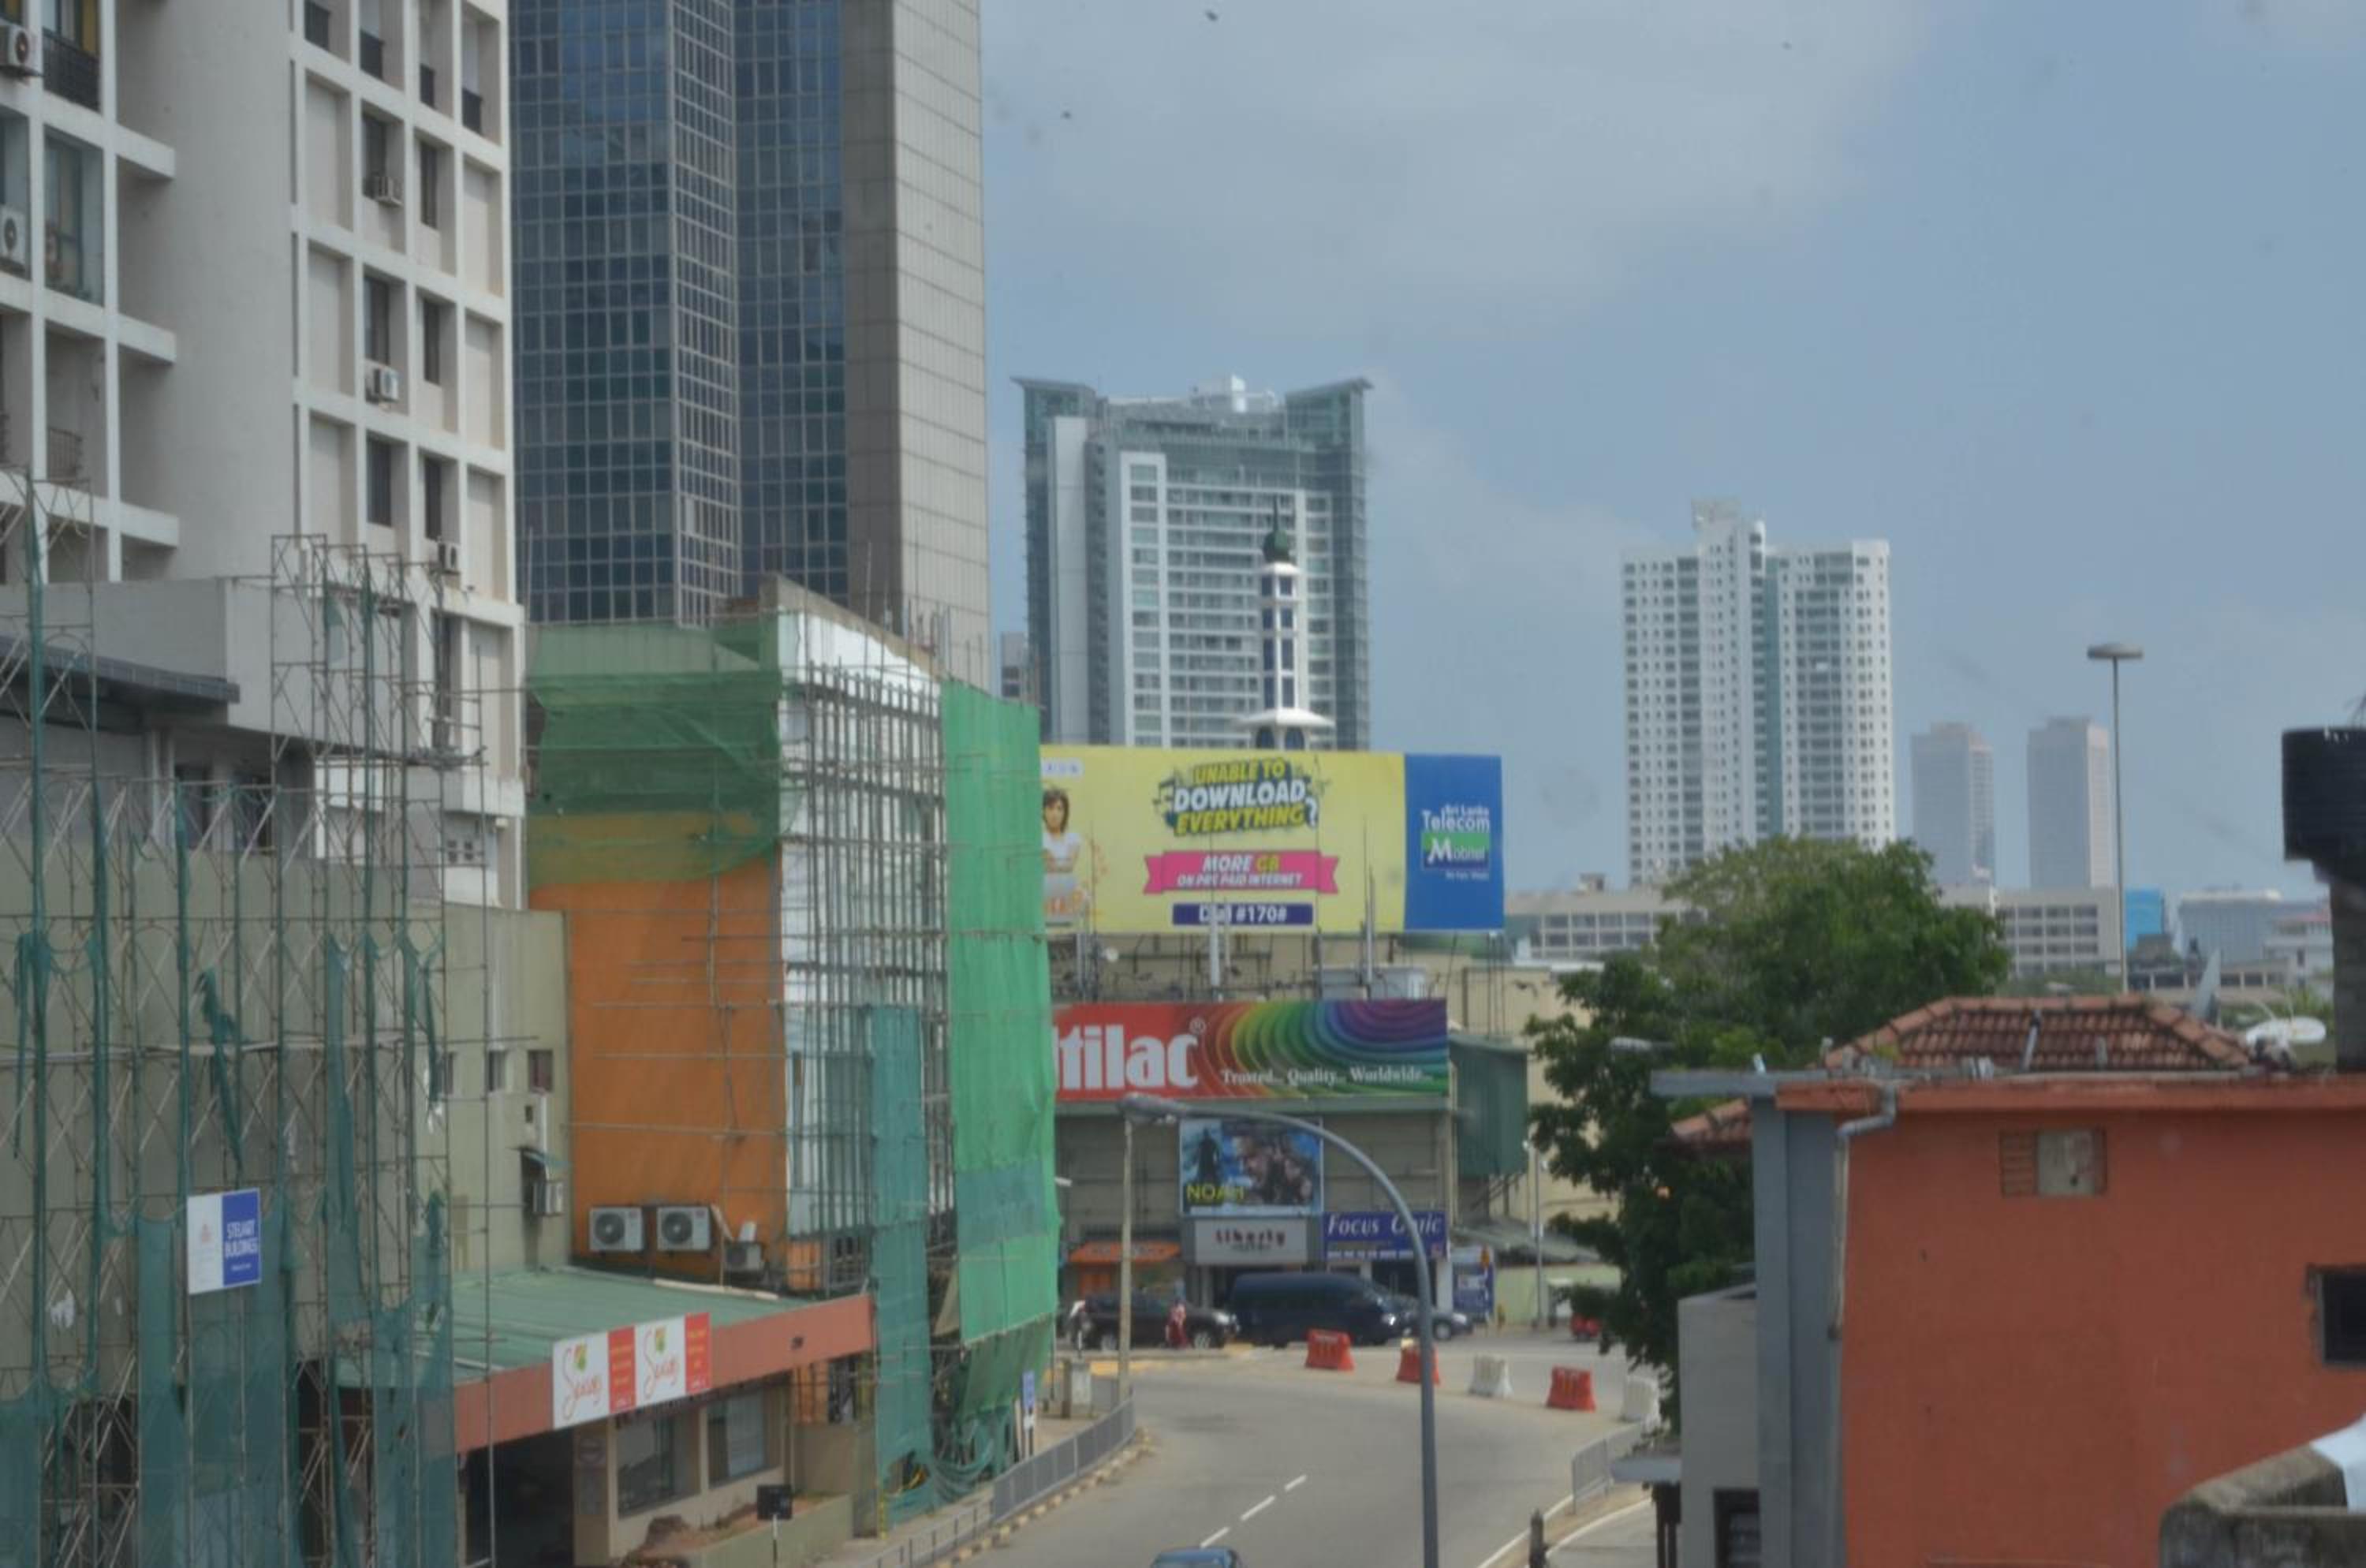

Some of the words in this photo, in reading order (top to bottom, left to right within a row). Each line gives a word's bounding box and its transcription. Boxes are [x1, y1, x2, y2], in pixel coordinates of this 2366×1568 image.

[1194, 759, 1260, 783] UNABLE
[1262, 757, 1286, 778] TO
[1174, 779, 1305, 812] DOWNLOAD
[1423, 809, 1490, 832] Telecom
[1204, 856, 1252, 872] MORE
[1199, 904, 1232, 922] Dal
[1236, 905, 1287, 921] #170#
[1054, 1024, 1198, 1089] tilac
[1328, 1215, 1379, 1236] Focus
